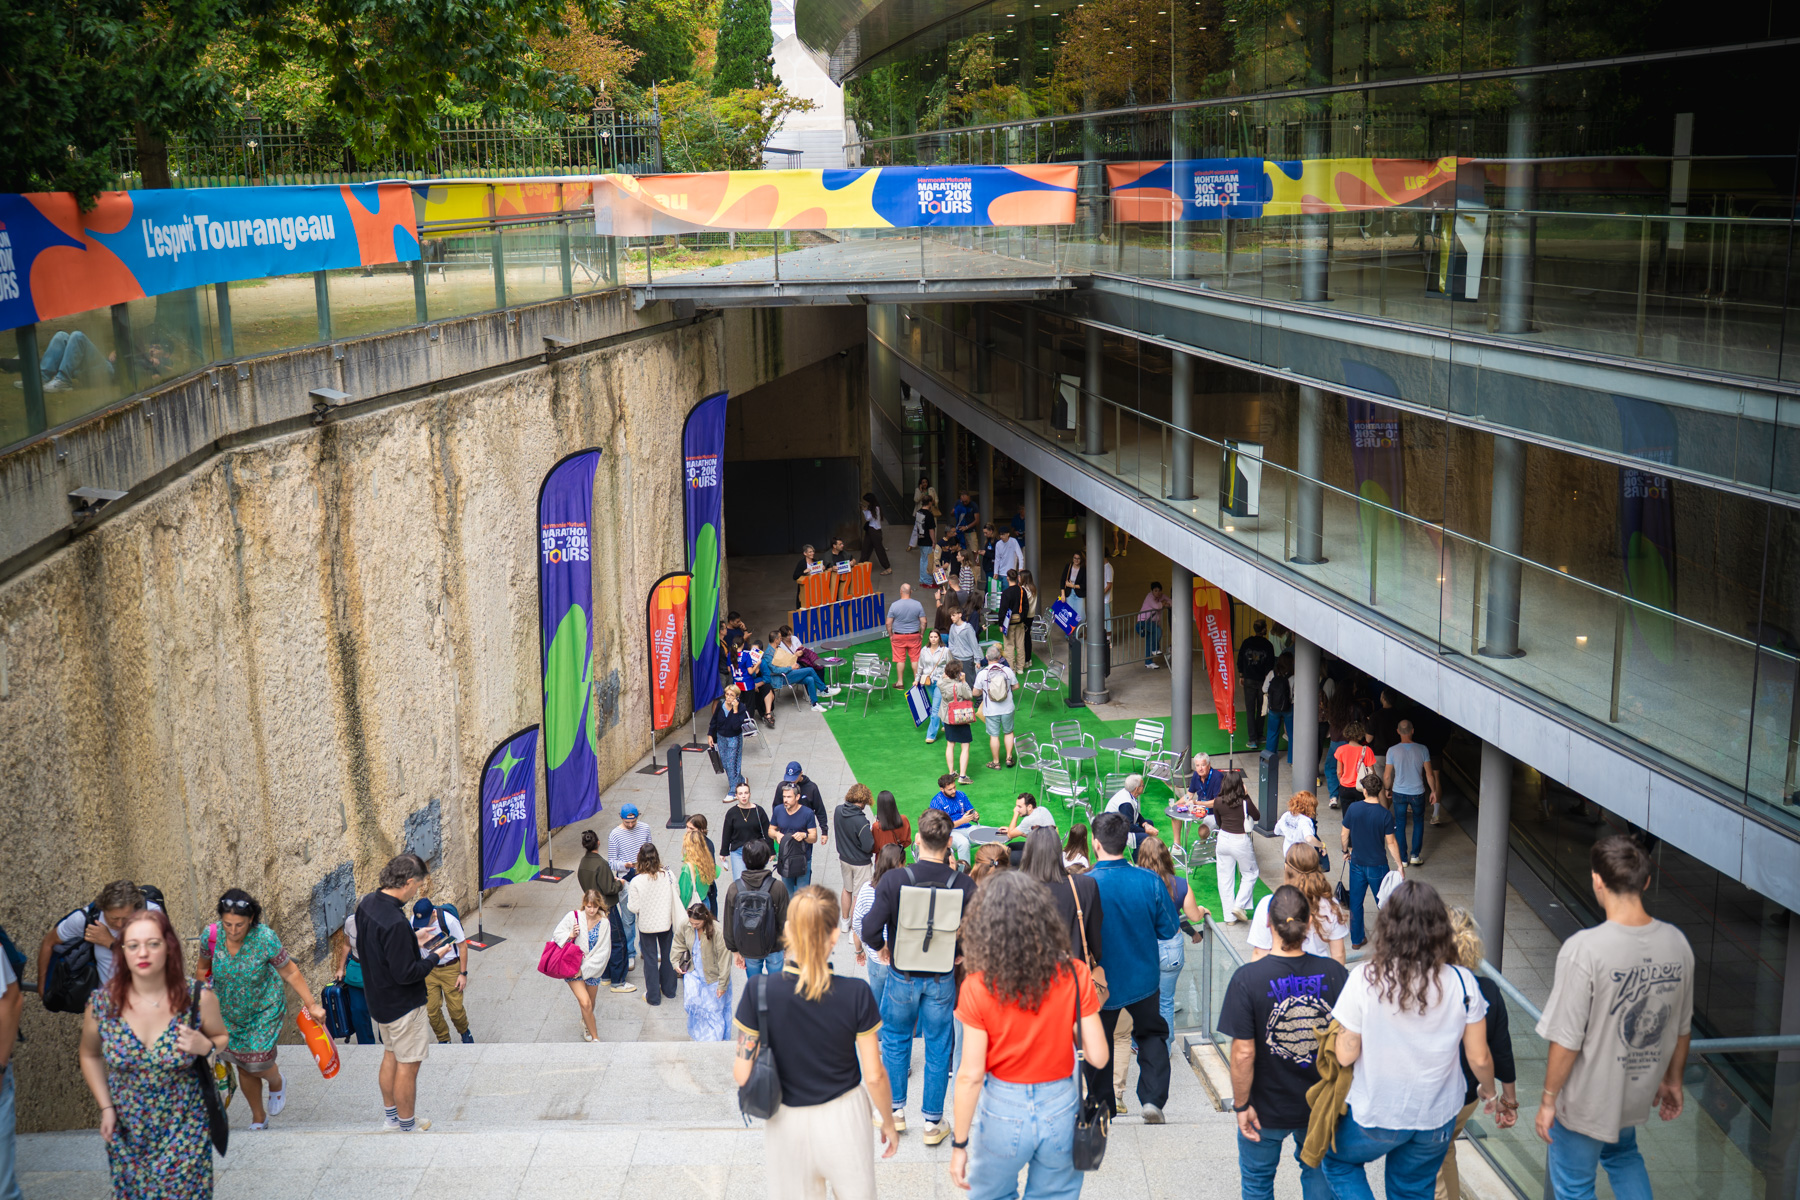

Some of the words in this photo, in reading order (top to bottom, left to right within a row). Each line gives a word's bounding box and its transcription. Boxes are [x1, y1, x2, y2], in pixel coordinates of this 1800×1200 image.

[917, 182, 972, 191] MARATHON
[918, 190, 934, 201] 10
[944, 190, 972, 201] 20K
[918, 200, 972, 214] TOURS
[142, 214, 196, 262] L'esprit
[193, 214, 336, 251] Tourangeau
[542, 537, 556, 550] 10
[565, 535, 589, 548] 20K
[542, 547, 590, 564] TOURS
[792, 592, 886, 645] MARATHON
[491, 808, 527, 828] TOURS
[492, 807, 503, 818] 10
